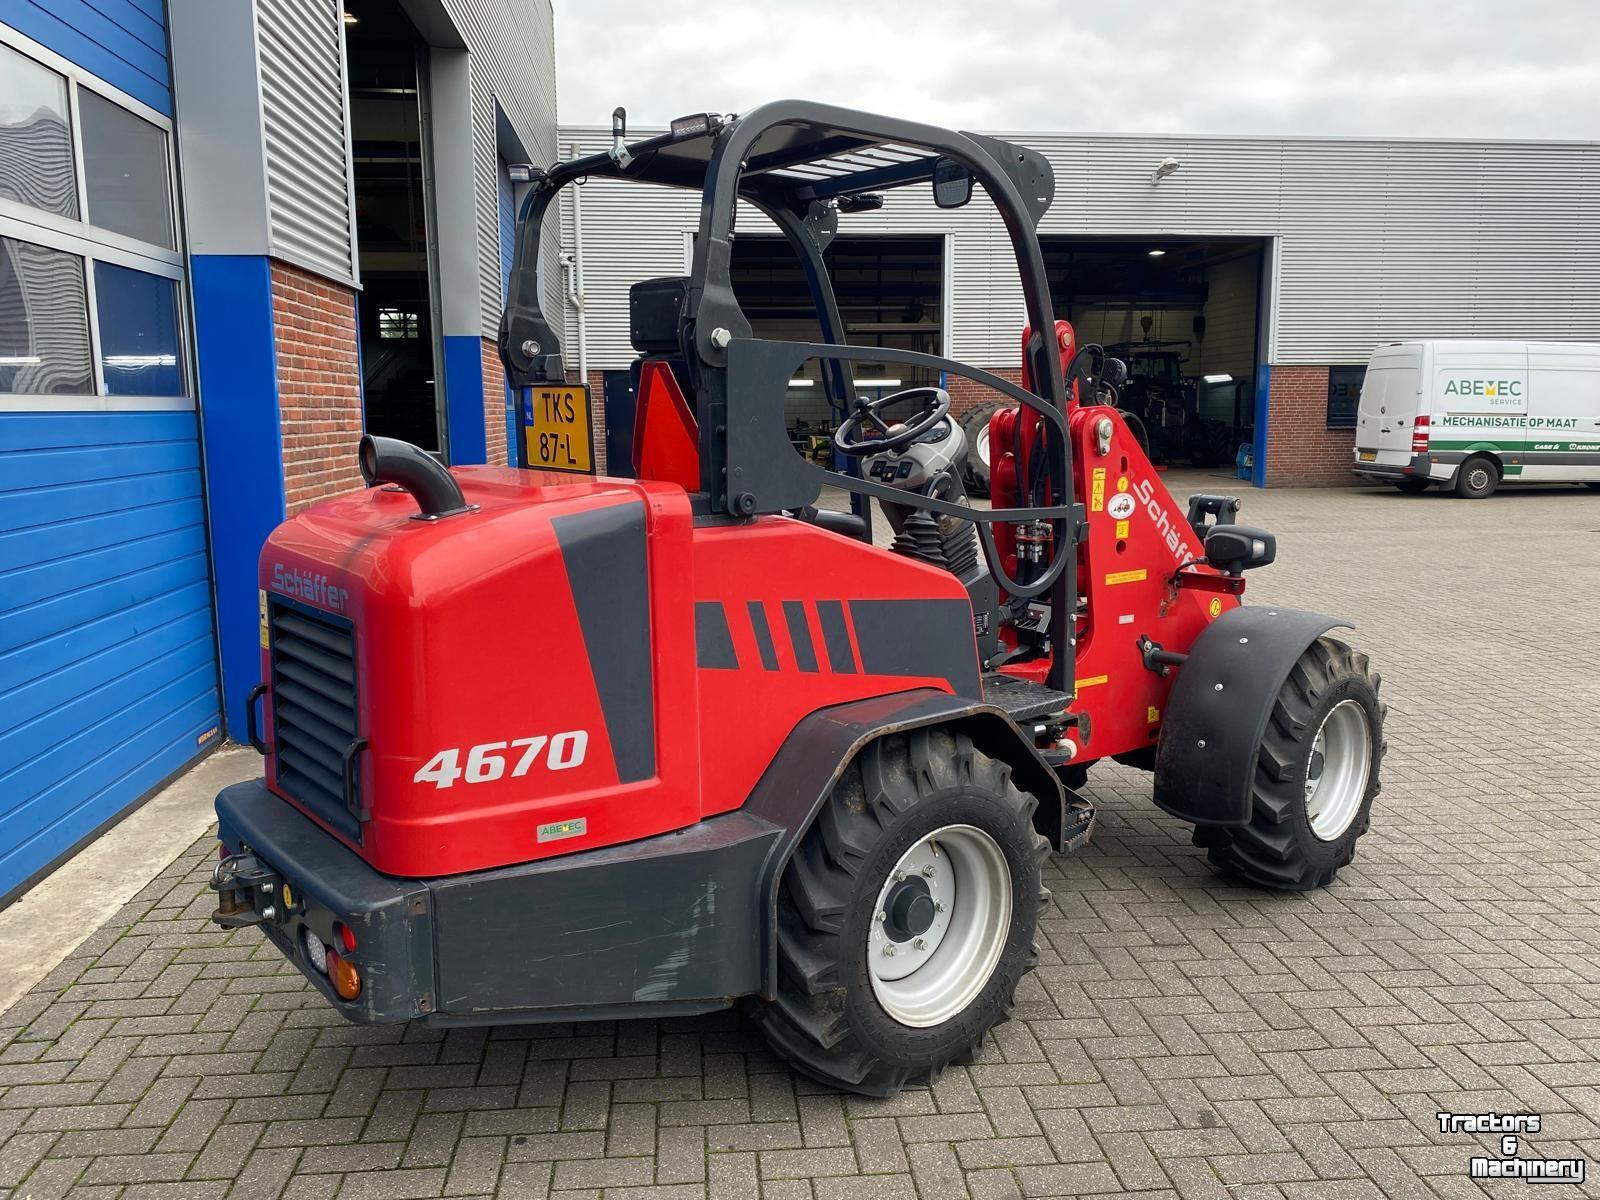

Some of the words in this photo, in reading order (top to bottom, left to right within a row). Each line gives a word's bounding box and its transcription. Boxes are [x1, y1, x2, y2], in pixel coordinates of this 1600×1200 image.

[1444, 380, 1522, 396] ABEMEC
[541, 392, 575, 423] TKS
[1442, 416, 1527, 427] MECHANISATIE
[1529, 417, 1544, 428] OP
[1546, 418, 1578, 428] MAAT
[539, 432, 577, 464] 87-L
[1132, 479, 1200, 574] Schäff
[271, 563, 349, 610] Schäffer
[413, 730, 589, 789] 4670
